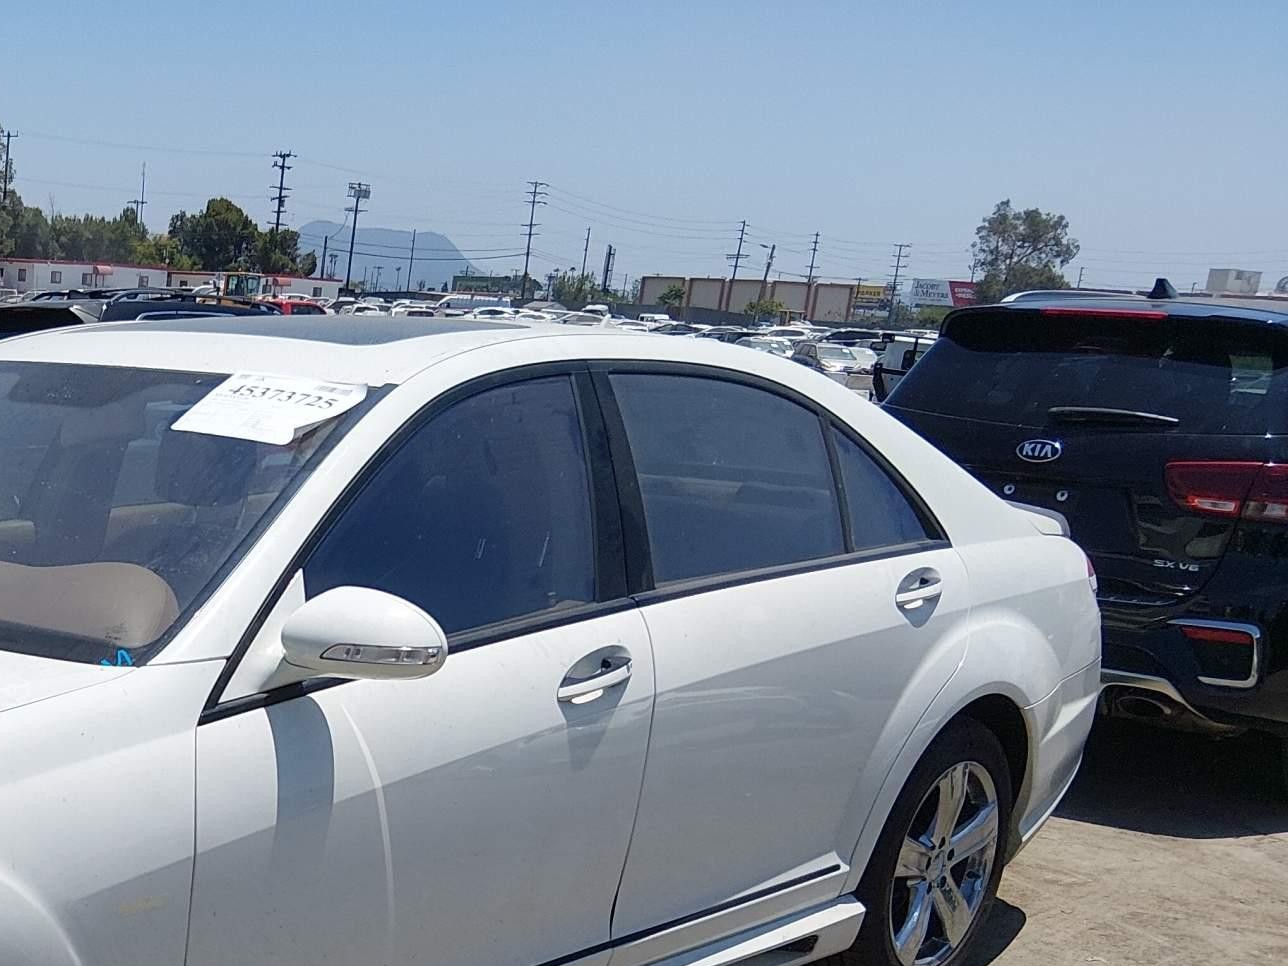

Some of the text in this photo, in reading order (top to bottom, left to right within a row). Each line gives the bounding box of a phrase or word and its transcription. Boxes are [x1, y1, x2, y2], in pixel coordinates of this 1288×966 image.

[229, 384, 340, 410] 45373725
[1023, 443, 1052, 458] KIA
[1153, 560, 1200, 572] SX V6
